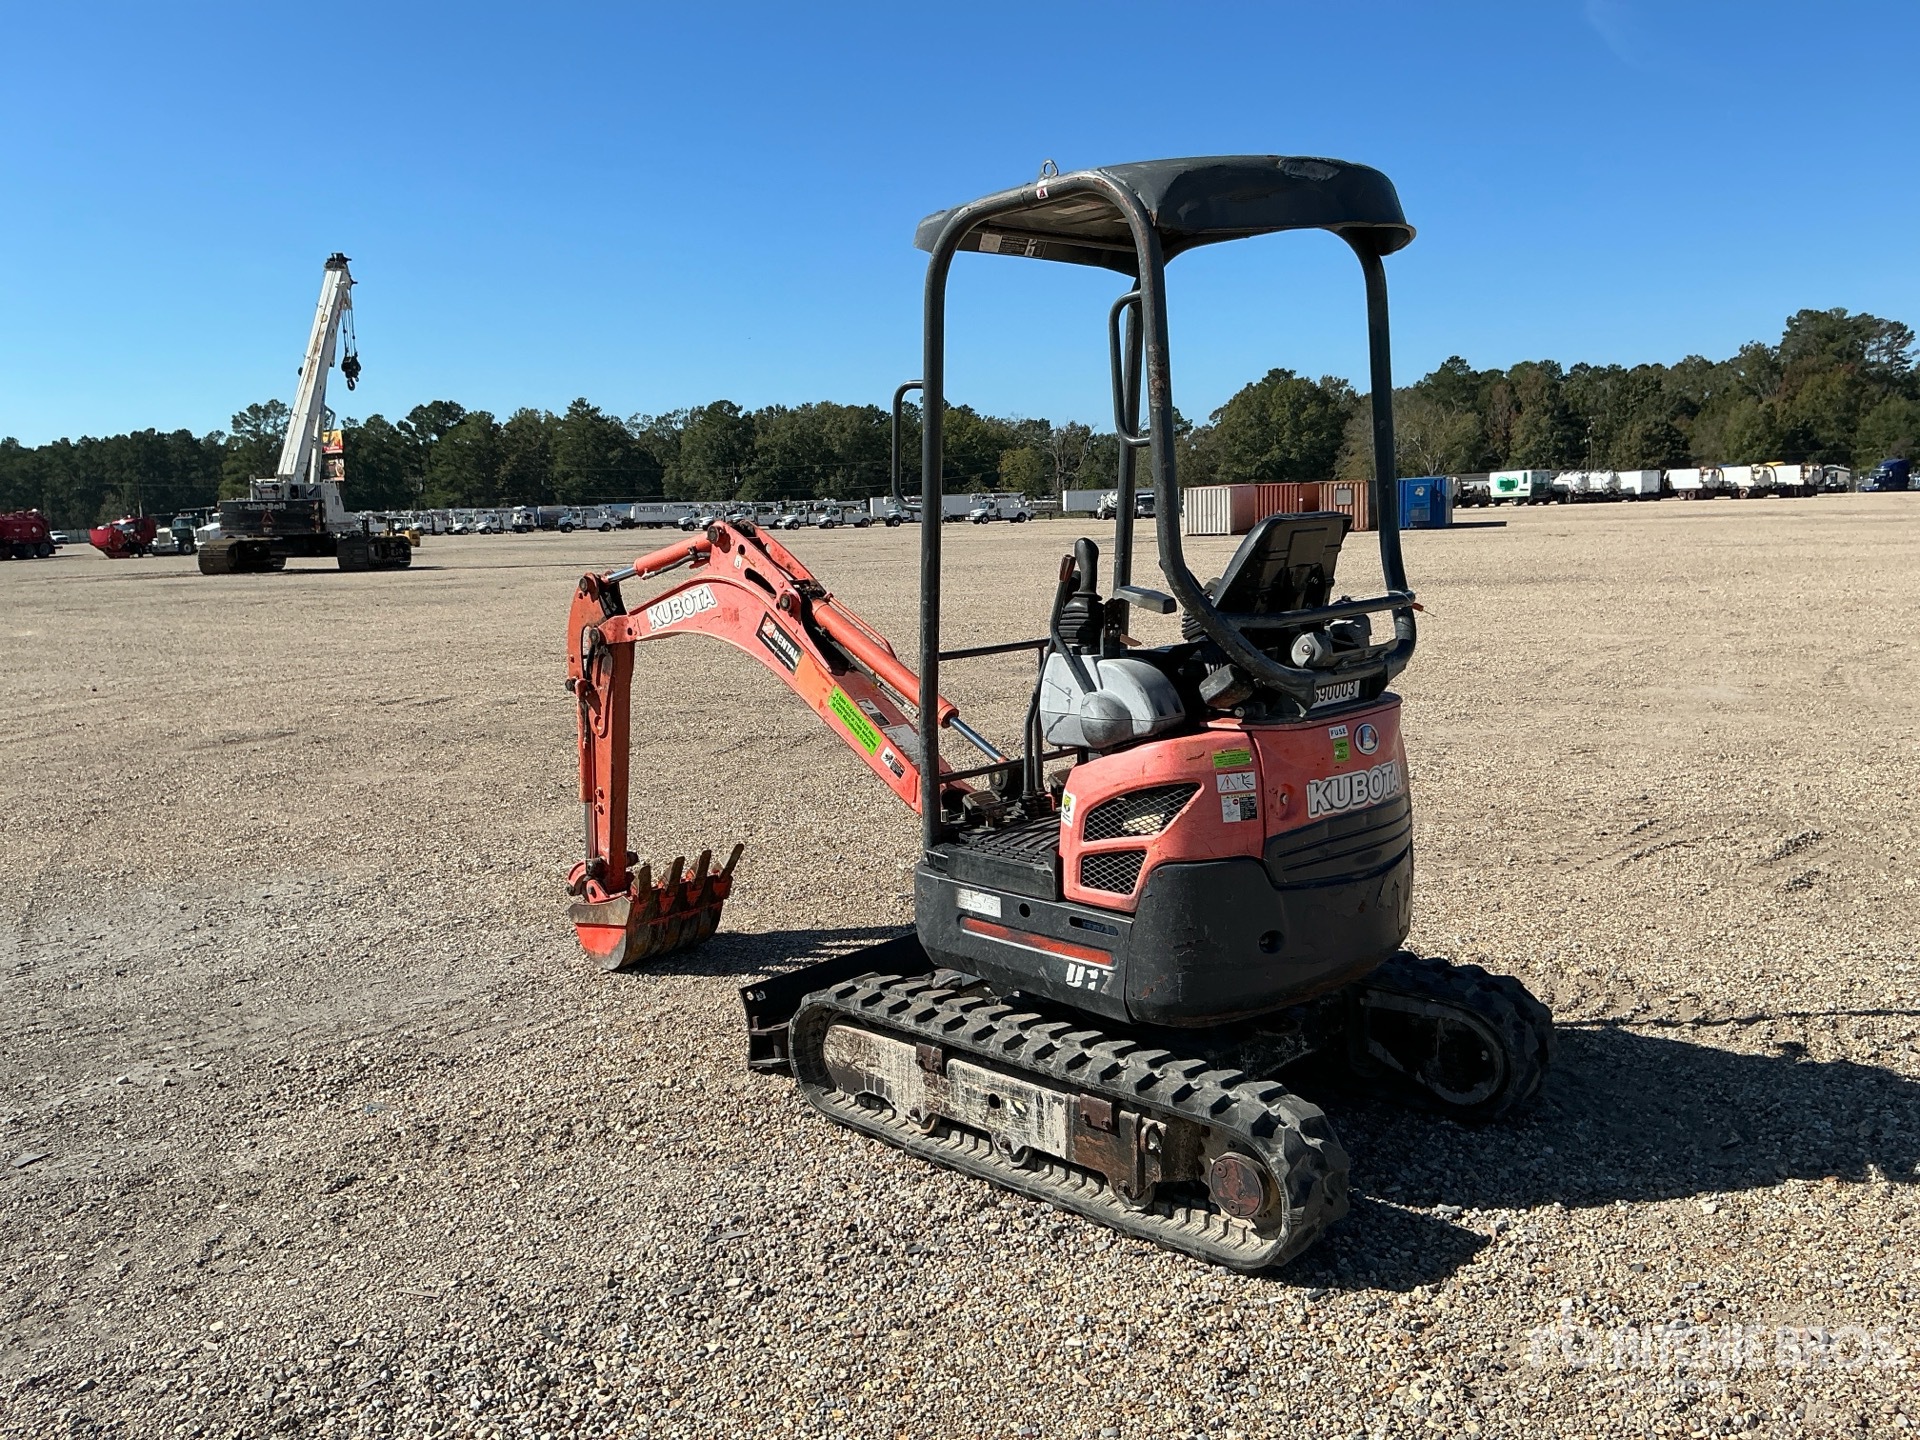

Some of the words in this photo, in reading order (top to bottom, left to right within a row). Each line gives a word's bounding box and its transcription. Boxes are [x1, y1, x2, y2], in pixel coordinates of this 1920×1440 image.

[647, 584, 718, 631] KUBOTA
[772, 628, 799, 664] RENTAL
[1330, 728, 1347, 737] FUSE
[1308, 760, 1401, 818] KUBOTA
